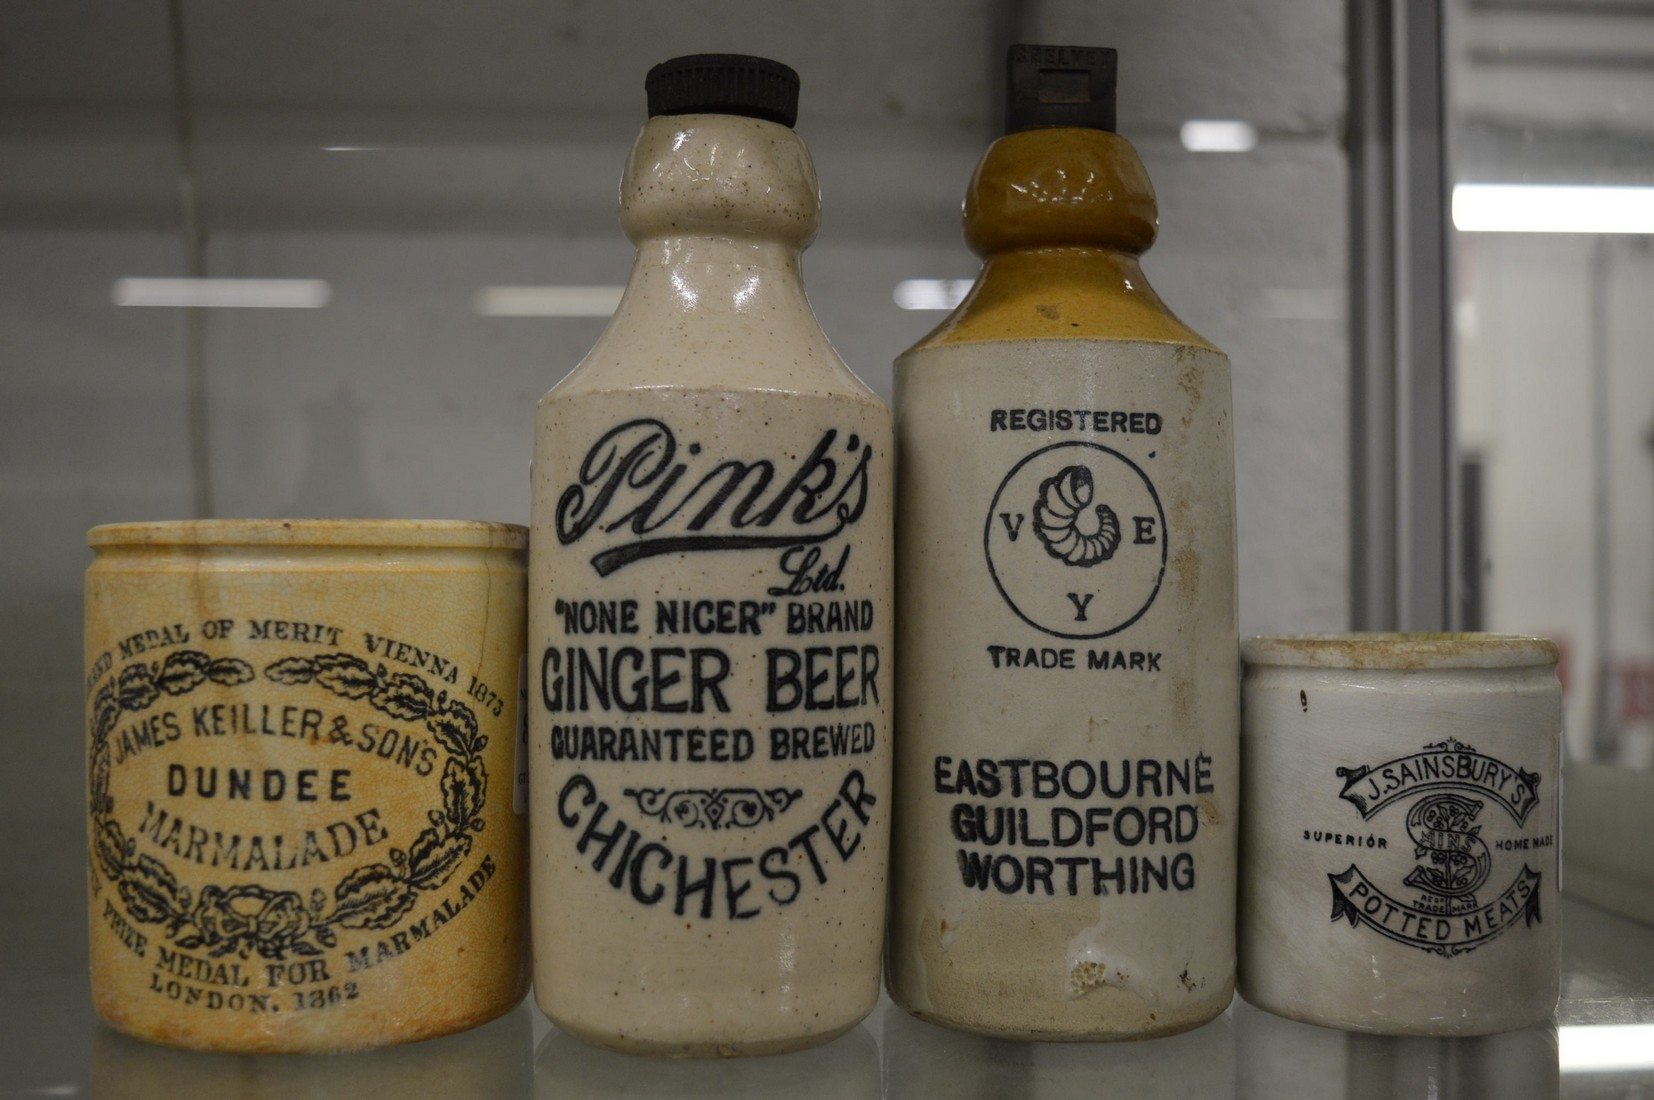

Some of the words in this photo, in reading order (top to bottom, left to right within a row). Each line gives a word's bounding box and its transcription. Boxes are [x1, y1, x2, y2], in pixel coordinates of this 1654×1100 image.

[990, 408, 1163, 435] REGISTERED
[555, 418, 873, 547] Pink's
[999, 512, 1025, 543] V
[1132, 516, 1157, 545] E
[767, 544, 851, 596] Ltd.
[786, 599, 874, 635] BRAND
[1066, 592, 1094, 621] Y
[119, 623, 190, 661] MEDAL
[203, 620, 235, 640] OF
[249, 619, 344, 647] MERIT
[364, 633, 458, 686] VIENNA
[466, 675, 504, 717] 1873
[541, 647, 732, 713] GINGER
[765, 645, 880, 713] BEER
[987, 645, 1076, 670] TRADE
[1087, 650, 1162, 672] MARK
[113, 711, 181, 765] JAMES
[551, 725, 755, 762] GUARANTEED
[769, 721, 876, 761] BREWED
[168, 763, 352, 802] DUNDEE
[934, 751, 1214, 800] EASTBOURNE
[138, 801, 388, 872] MARMALADE
[558, 769, 877, 920] CHICHESTER
[950, 803, 1199, 847] GUILDFORD
[1303, 829, 1388, 850] SUPERIOR
[1495, 838, 1529, 851] HOME
[957, 849, 1195, 896] WORTHING
[103, 900, 148, 958] PRIZE
[156, 946, 250, 987] MEDAL
[267, 959, 331, 988] FOR
[346, 854, 497, 974] MARMALADE
[1349, 881, 1451, 941] POTTED
[1464, 879, 1532, 938] MEATS
[1413, 900, 1444, 913] TRADE
[1452, 902, 1479, 913] MARK
[295, 981, 360, 1011] 1862
